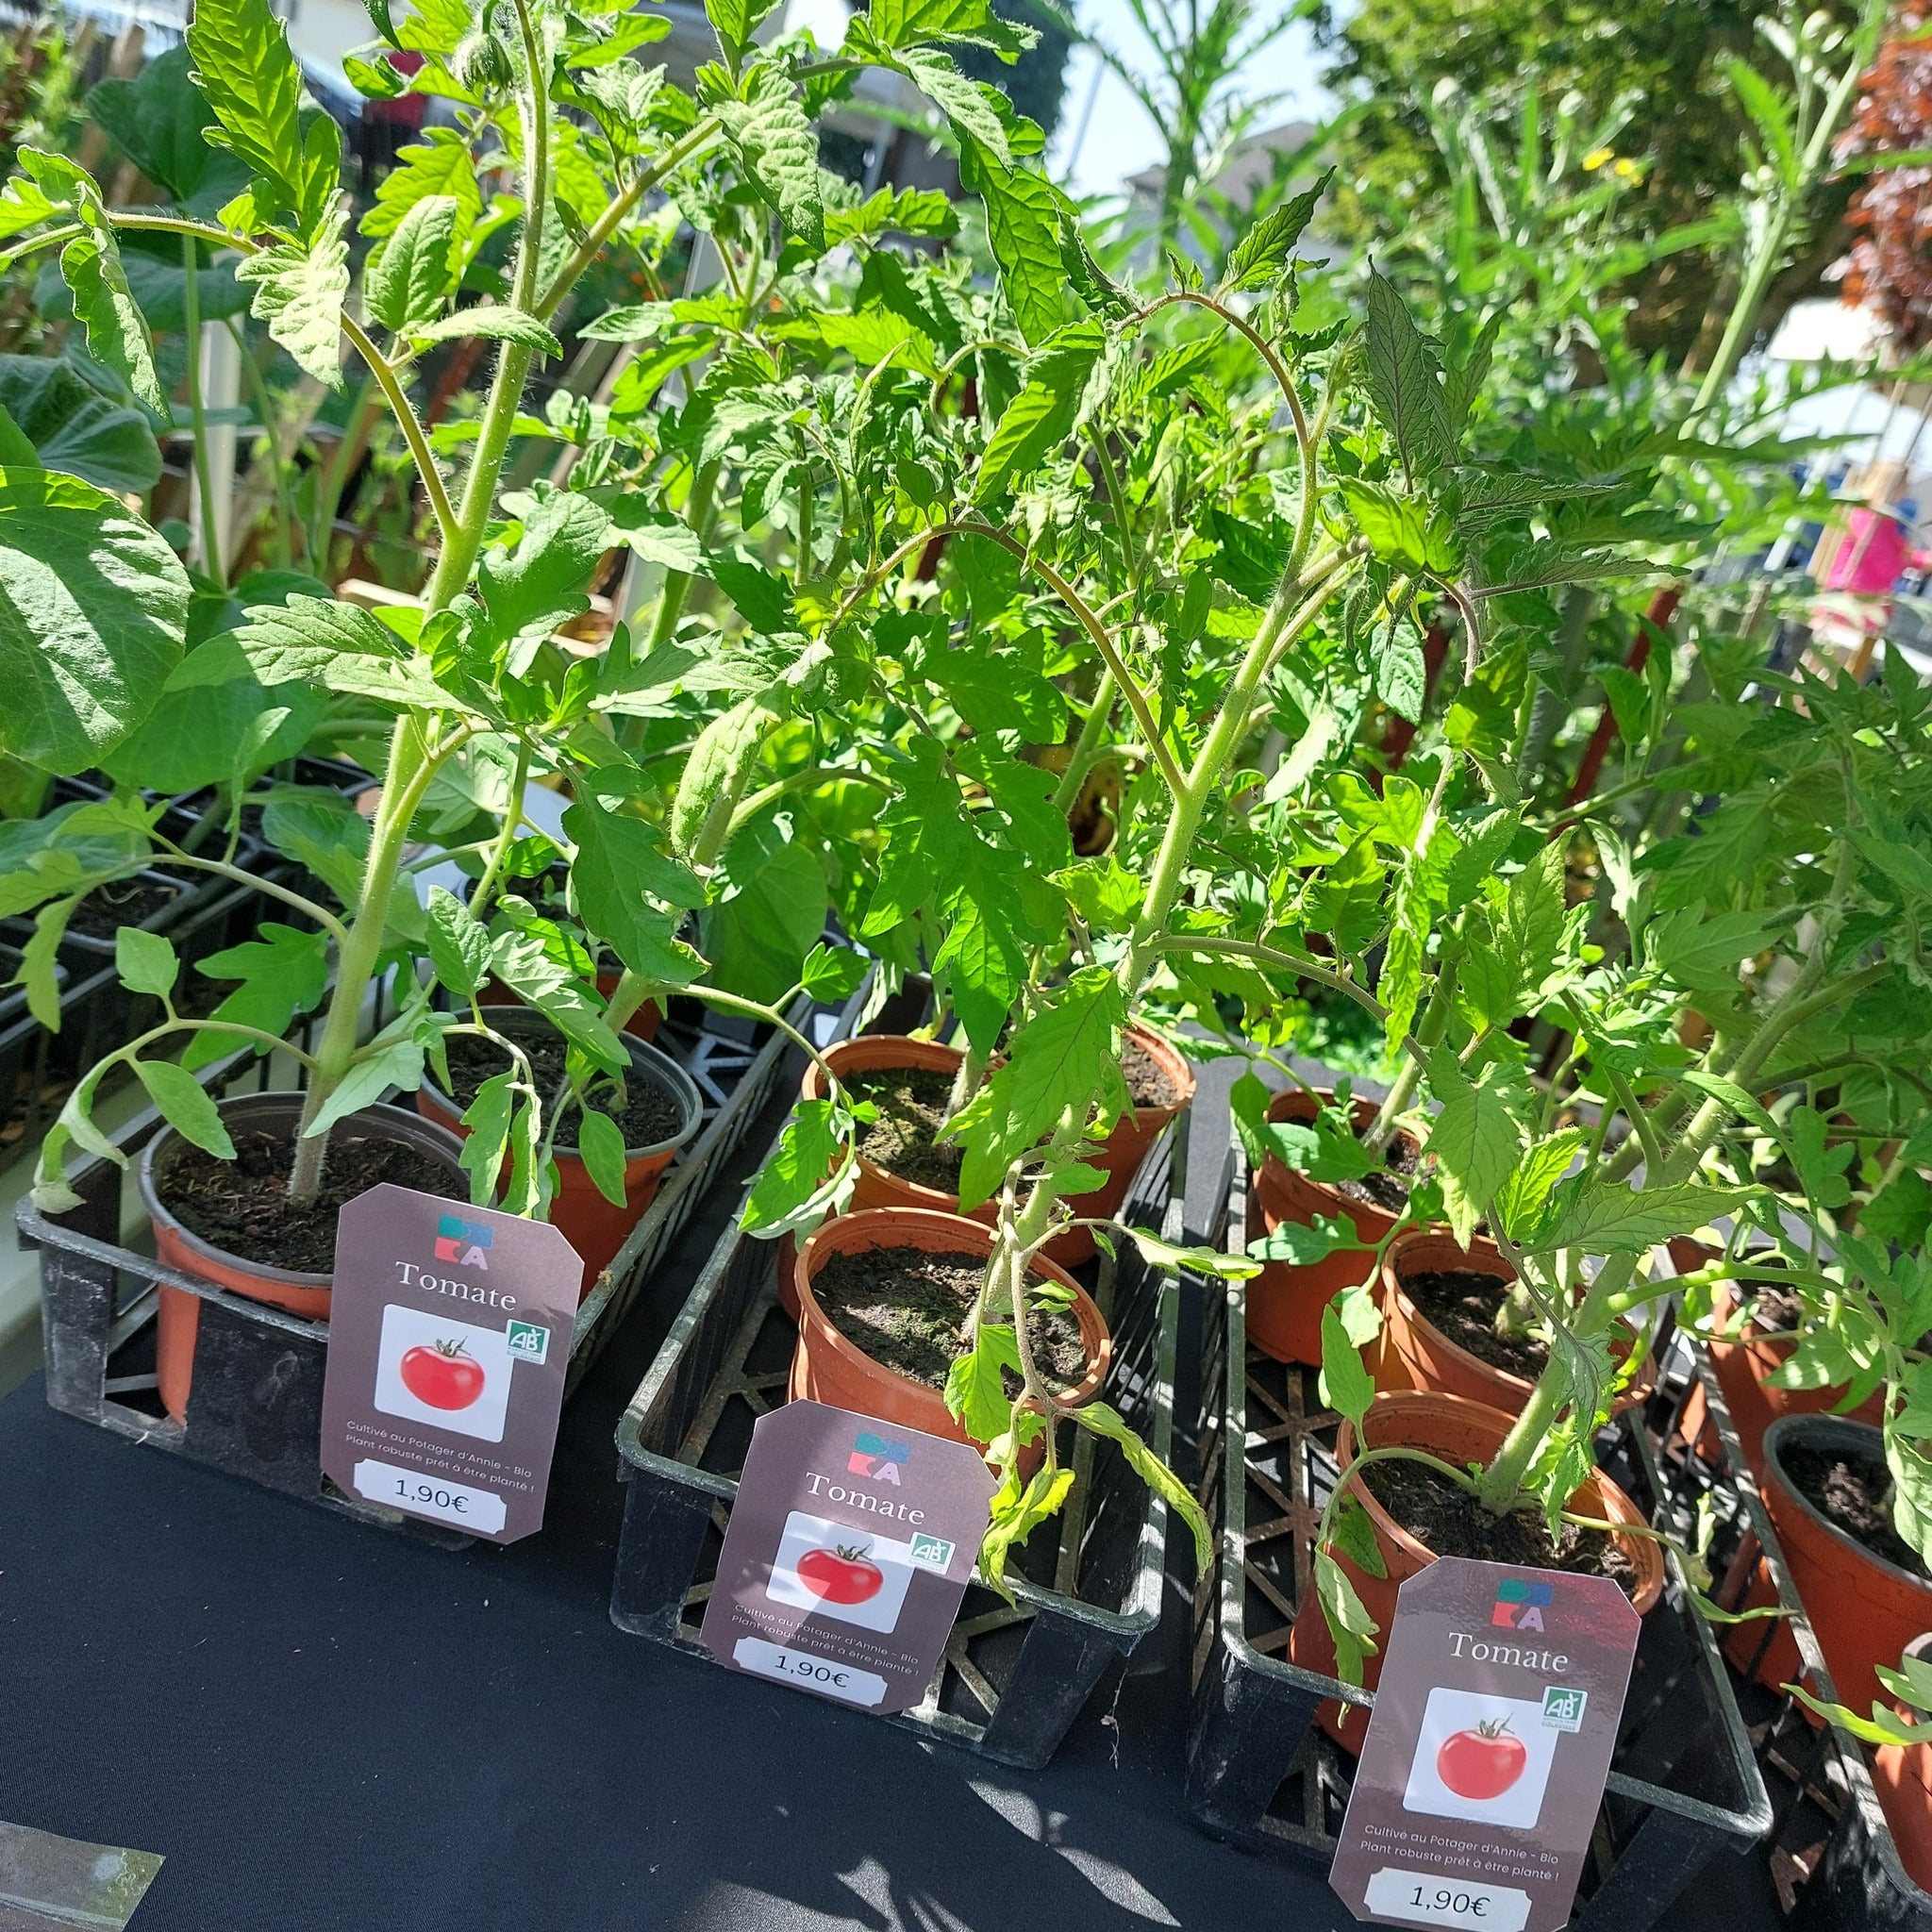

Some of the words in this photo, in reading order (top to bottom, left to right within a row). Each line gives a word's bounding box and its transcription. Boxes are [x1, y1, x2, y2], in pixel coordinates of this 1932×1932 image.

[395, 1260, 517, 1310] Tomate
[510, 1327, 542, 1351] AB
[346, 1434, 375, 1449] Plant
[378, 1443, 423, 1462] robuste
[425, 1456, 449, 1472] prêt
[453, 1462, 460, 1473] à
[463, 1464, 487, 1480] être
[490, 1474, 527, 1491] planté
[347, 1420, 387, 1439] Cultivé
[391, 1432, 406, 1444] au
[408, 1437, 455, 1457] Potager
[514, 1465, 532, 1478] Bio
[395, 1479, 469, 1513] 1,90€
[806, 1472, 924, 1525] Tomate
[912, 1541, 947, 1562] AB
[732, 1614, 761, 1630] Plant
[763, 1624, 808, 1643] robuste
[810, 1639, 835, 1654] prêt
[838, 1645, 846, 1656] à
[848, 1648, 872, 1662] être
[874, 1657, 912, 1675] planté
[735, 1604, 774, 1622] Cultivé
[778, 1616, 793, 1627] au
[796, 1622, 841, 1642] Potager
[900, 1653, 919, 1664] Bio
[1449, 1632, 1568, 1673] Tomate
[774, 1655, 850, 1689] 1,90€
[1546, 1692, 1579, 1718] AB
[1360, 1840, 1391, 1855] Plant
[1394, 1846, 1441, 1863] robuste
[1444, 1854, 1471, 1870] prêt
[1474, 1858, 1482, 1870] à
[1485, 1859, 1509, 1874] être
[1512, 1865, 1552, 1882] planté
[1365, 1824, 1407, 1840] Cultivé
[1410, 1832, 1426, 1843] au
[1430, 1834, 1478, 1853] Potager
[1540, 1852, 1558, 1865] Bio
[1409, 1887, 1491, 1917] 1,90€
